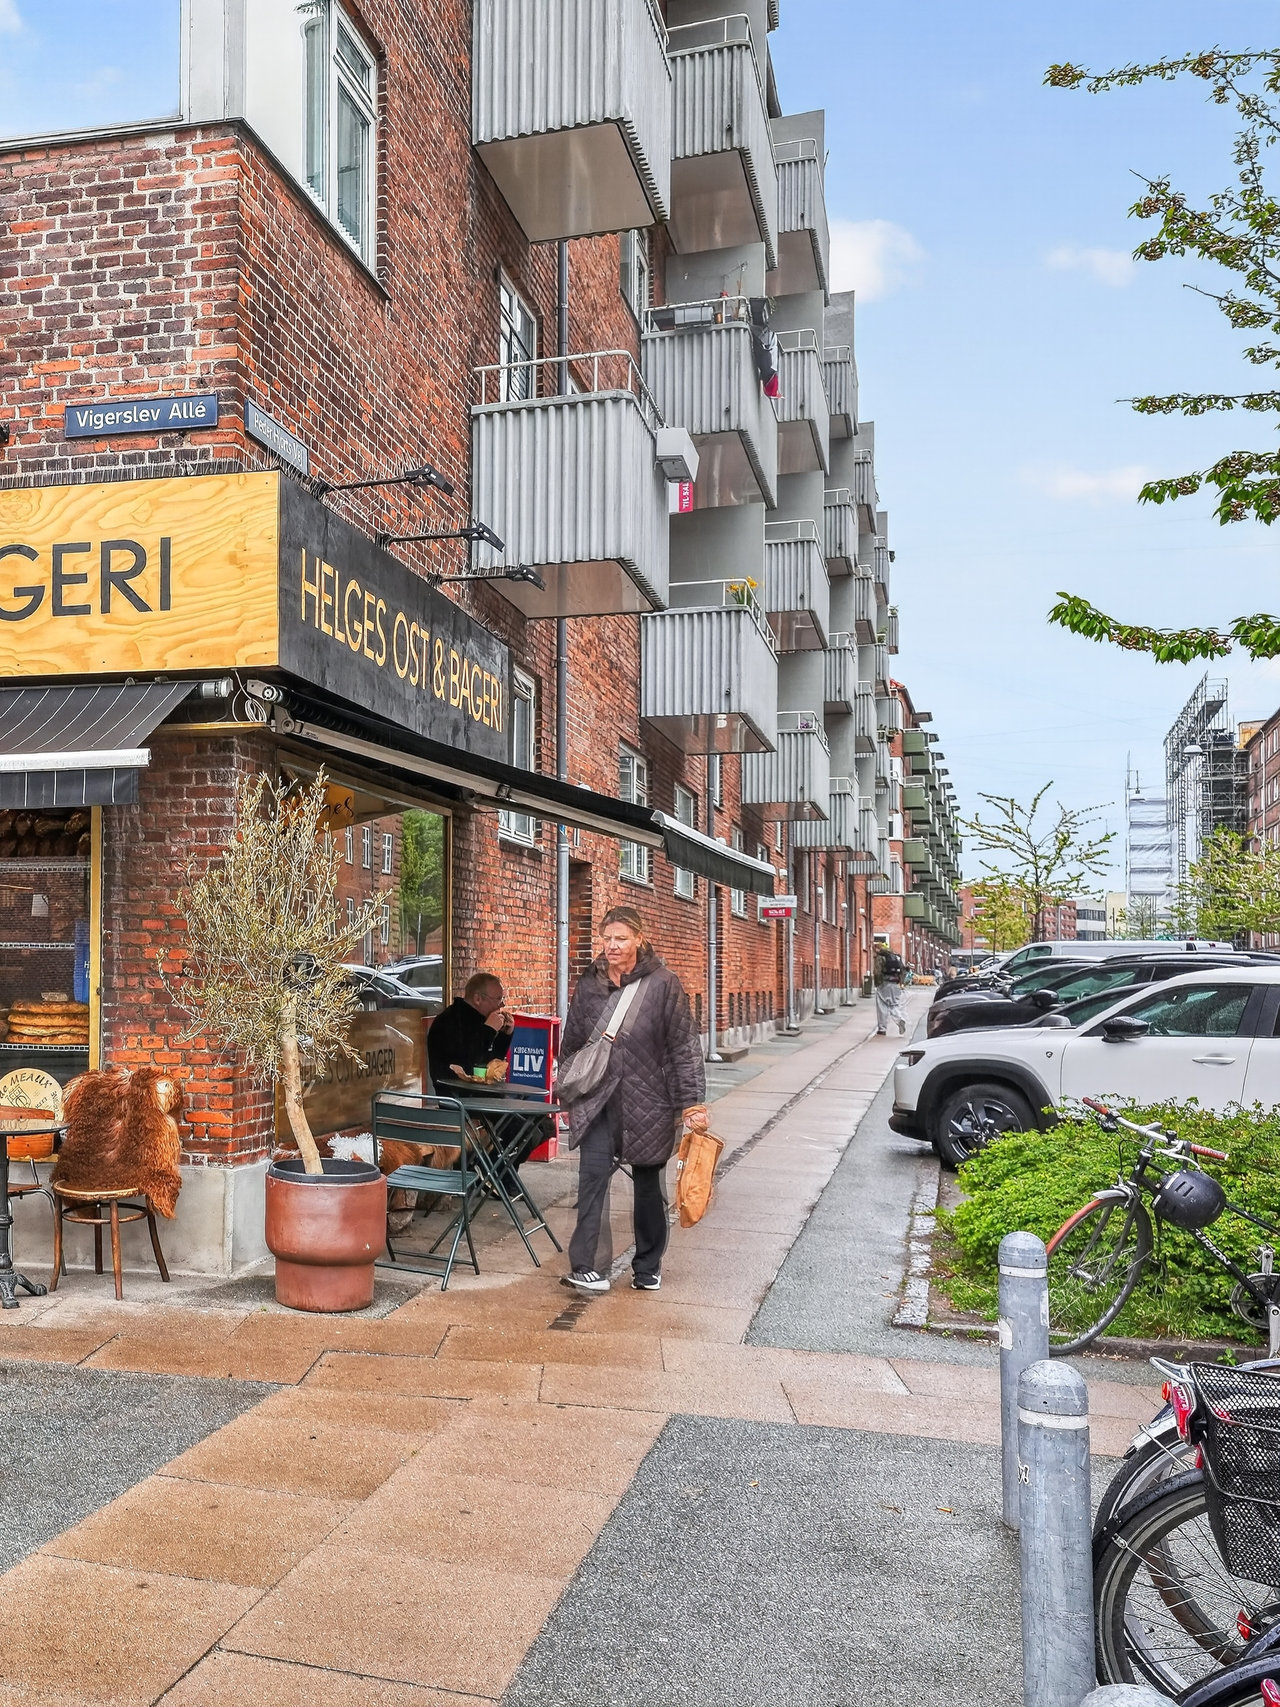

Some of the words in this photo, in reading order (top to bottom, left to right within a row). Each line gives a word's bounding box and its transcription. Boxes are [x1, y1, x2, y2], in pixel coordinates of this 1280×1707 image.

[76, 405, 161, 430] Vigerslev
[169, 401, 207, 420] Allé
[301, 547, 388, 668] HELGES
[393, 611, 431, 690] OST
[433, 637, 446, 701] &
[449, 648, 505, 734] BAGERI
[513, 1054, 544, 1072] LIV
